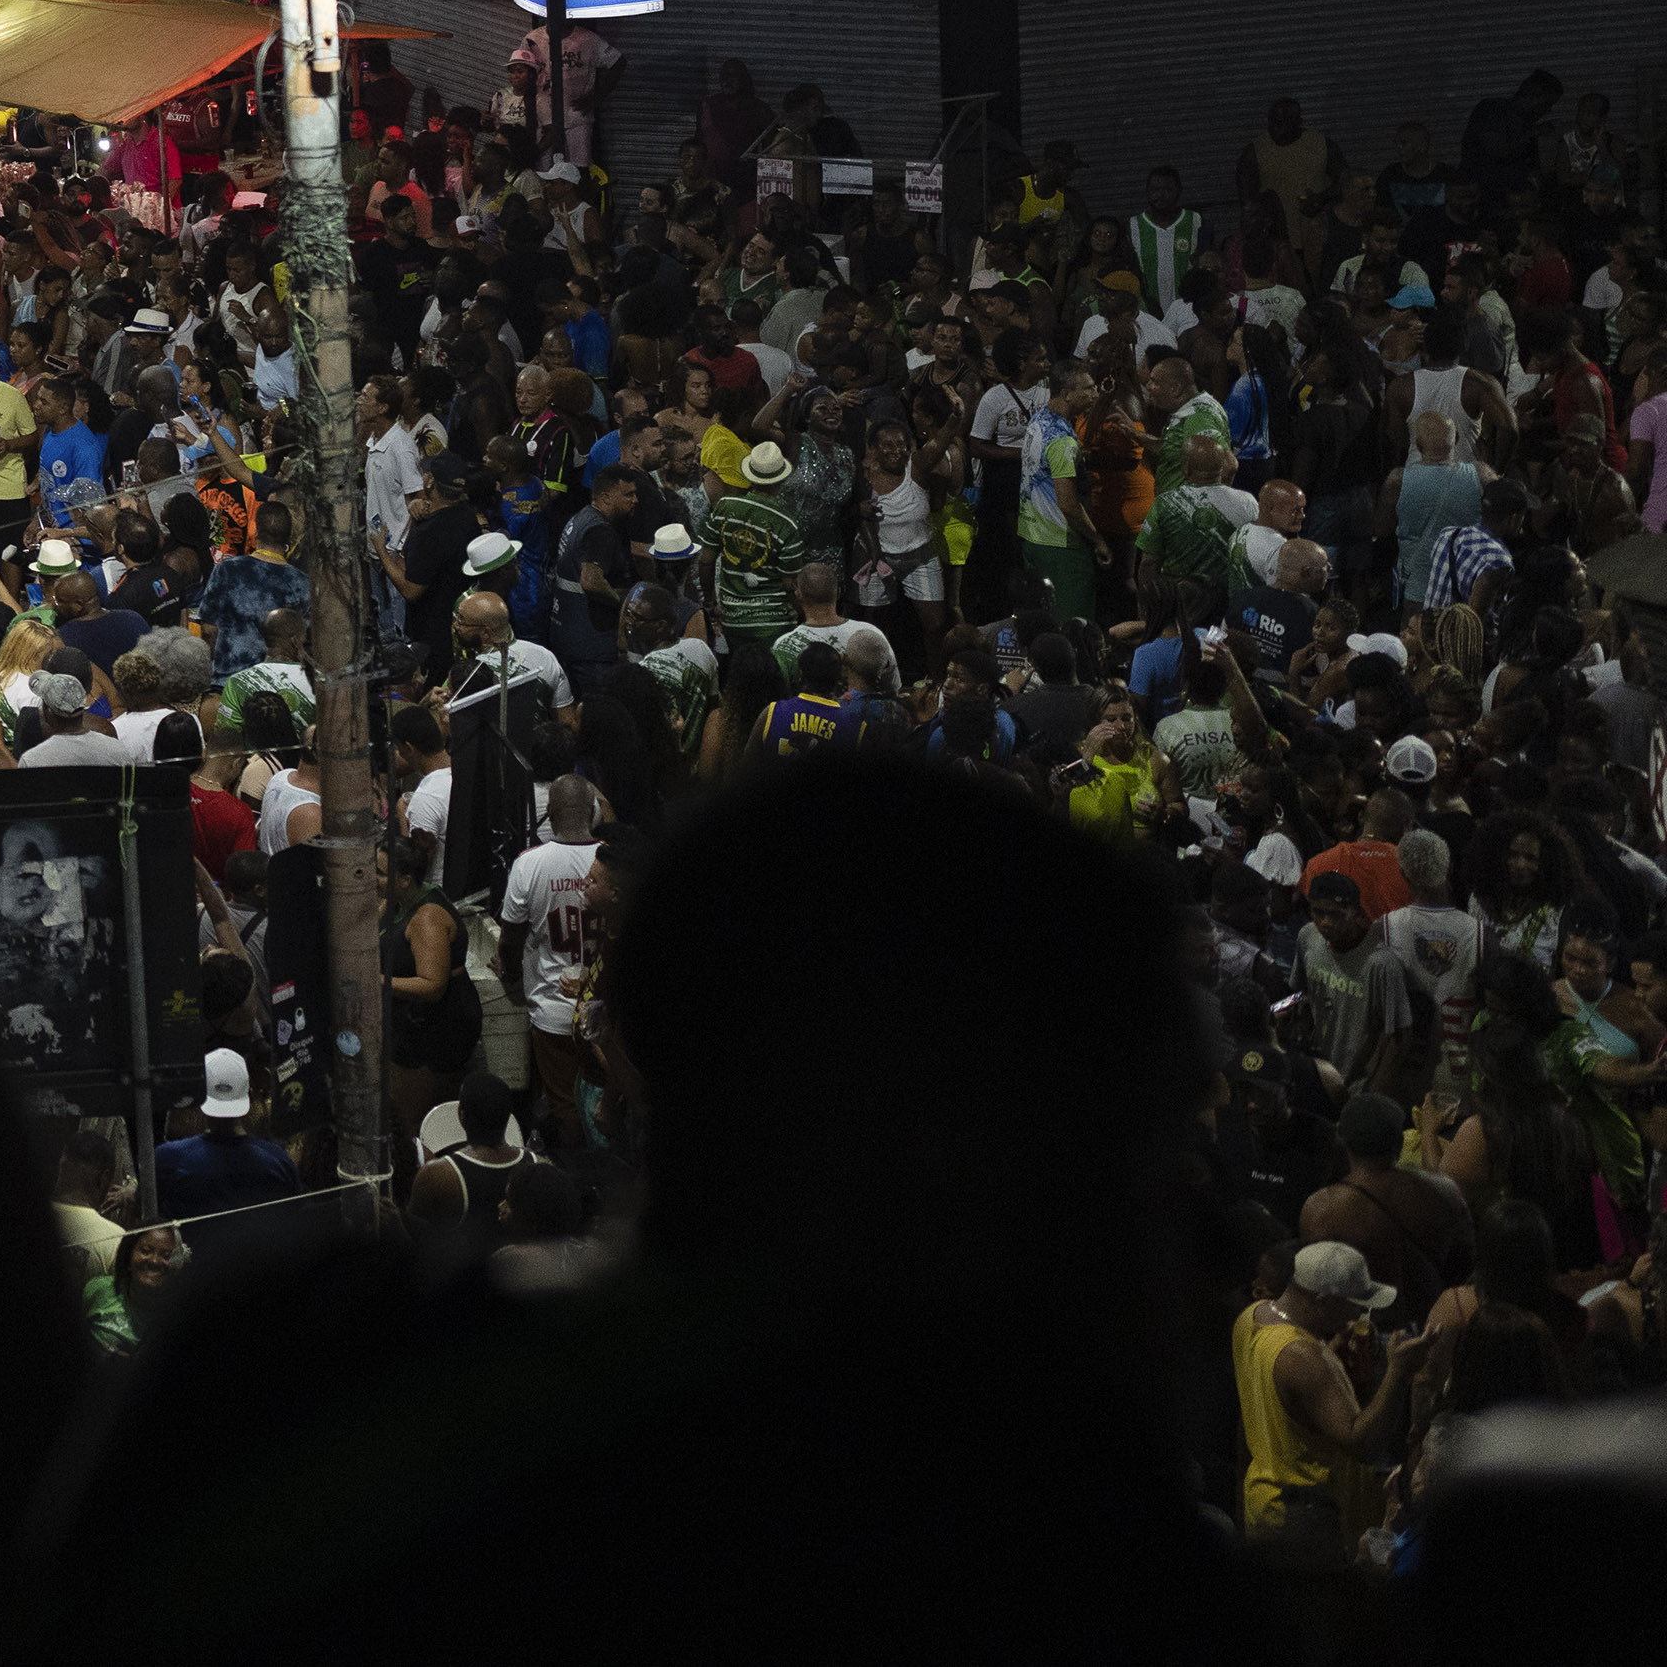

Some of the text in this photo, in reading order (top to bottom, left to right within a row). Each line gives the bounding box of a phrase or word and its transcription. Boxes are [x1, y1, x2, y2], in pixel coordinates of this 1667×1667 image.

[1259, 614, 1285, 636] Rio
[790, 711, 837, 741] JAMES
[1183, 731, 1232, 746] ENSA
